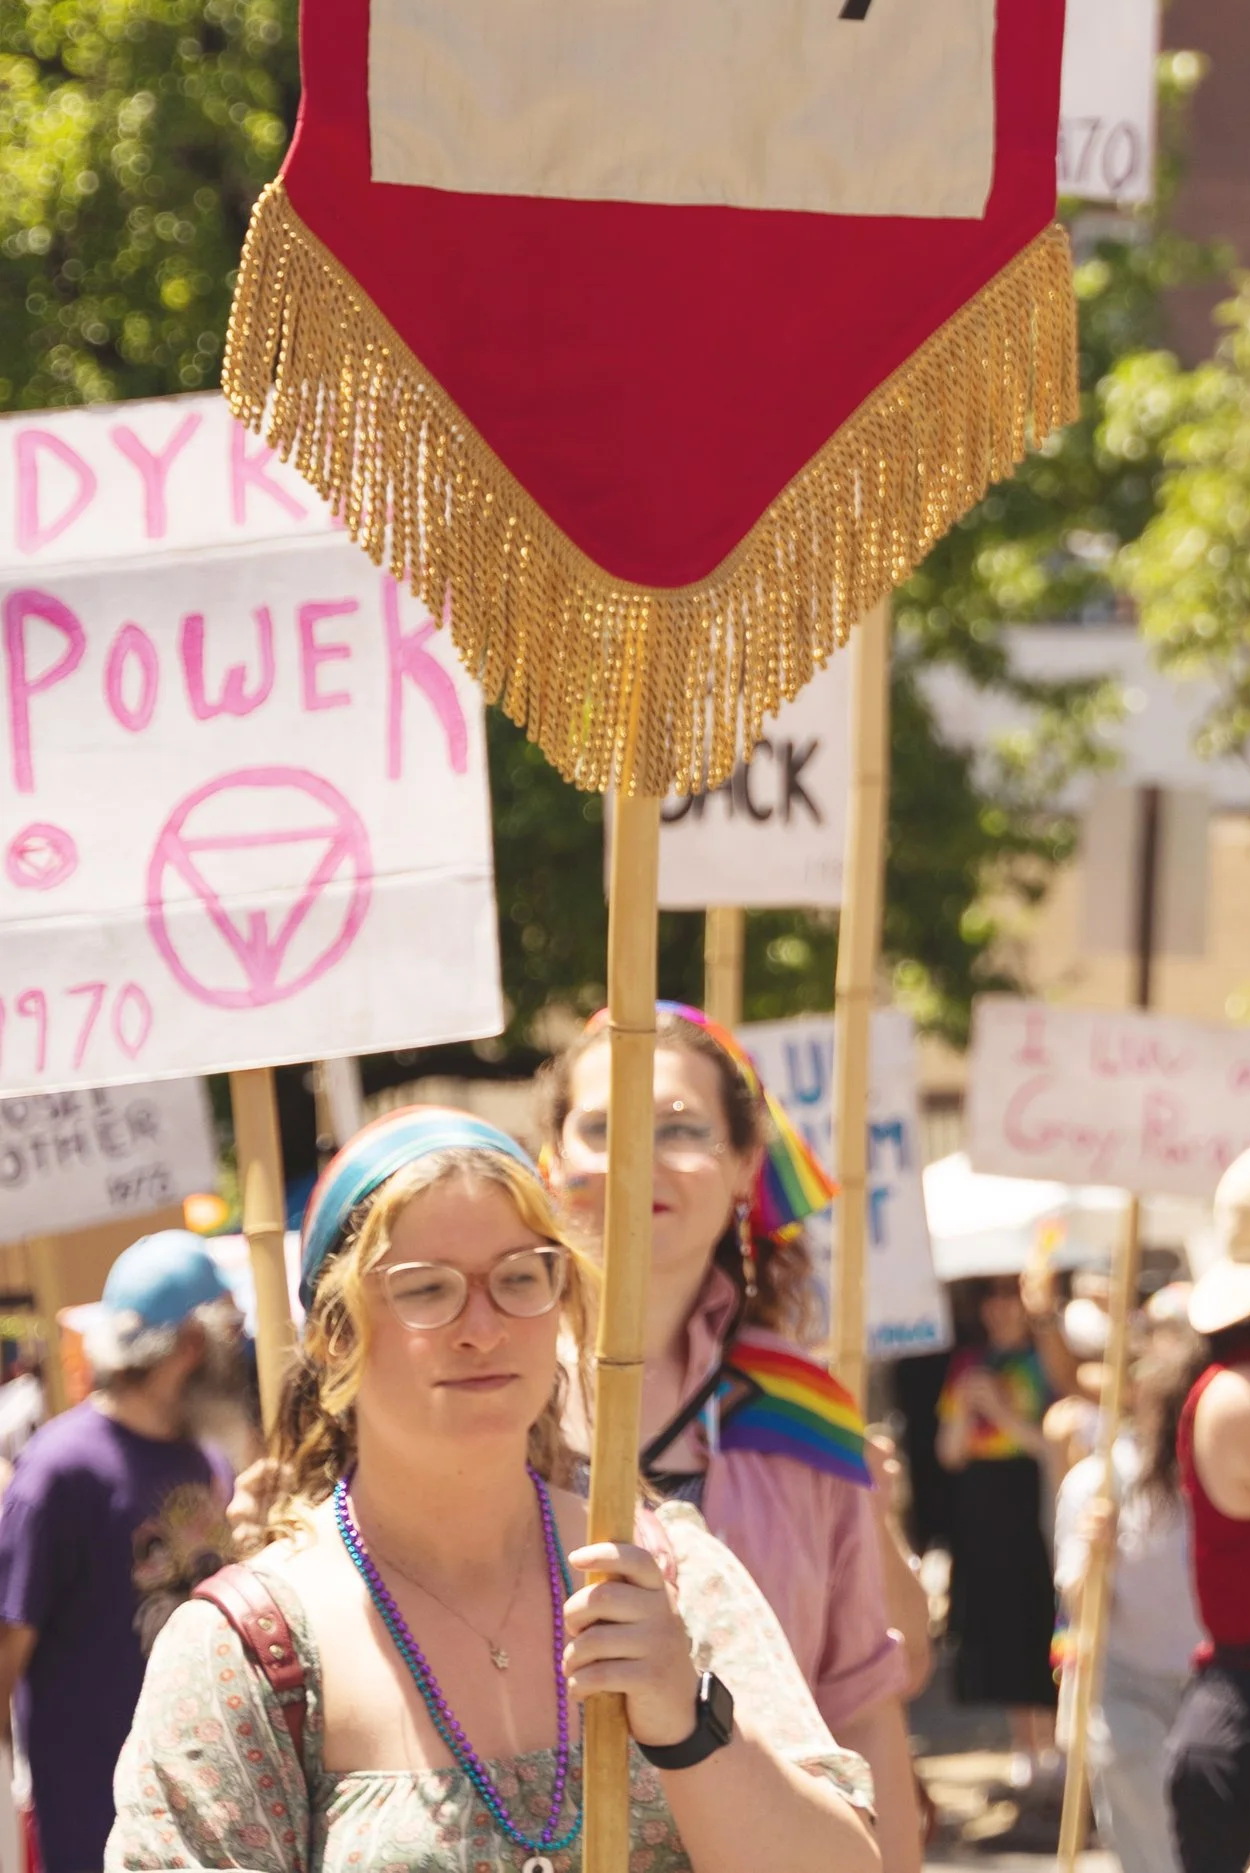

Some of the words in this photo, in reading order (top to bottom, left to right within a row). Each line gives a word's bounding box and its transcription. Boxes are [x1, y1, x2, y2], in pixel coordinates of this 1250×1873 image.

[1058, 117, 1139, 191] 70
[16, 411, 362, 556] DYK
[2, 569, 469, 794] POWER
[660, 735, 825, 828] ACK
